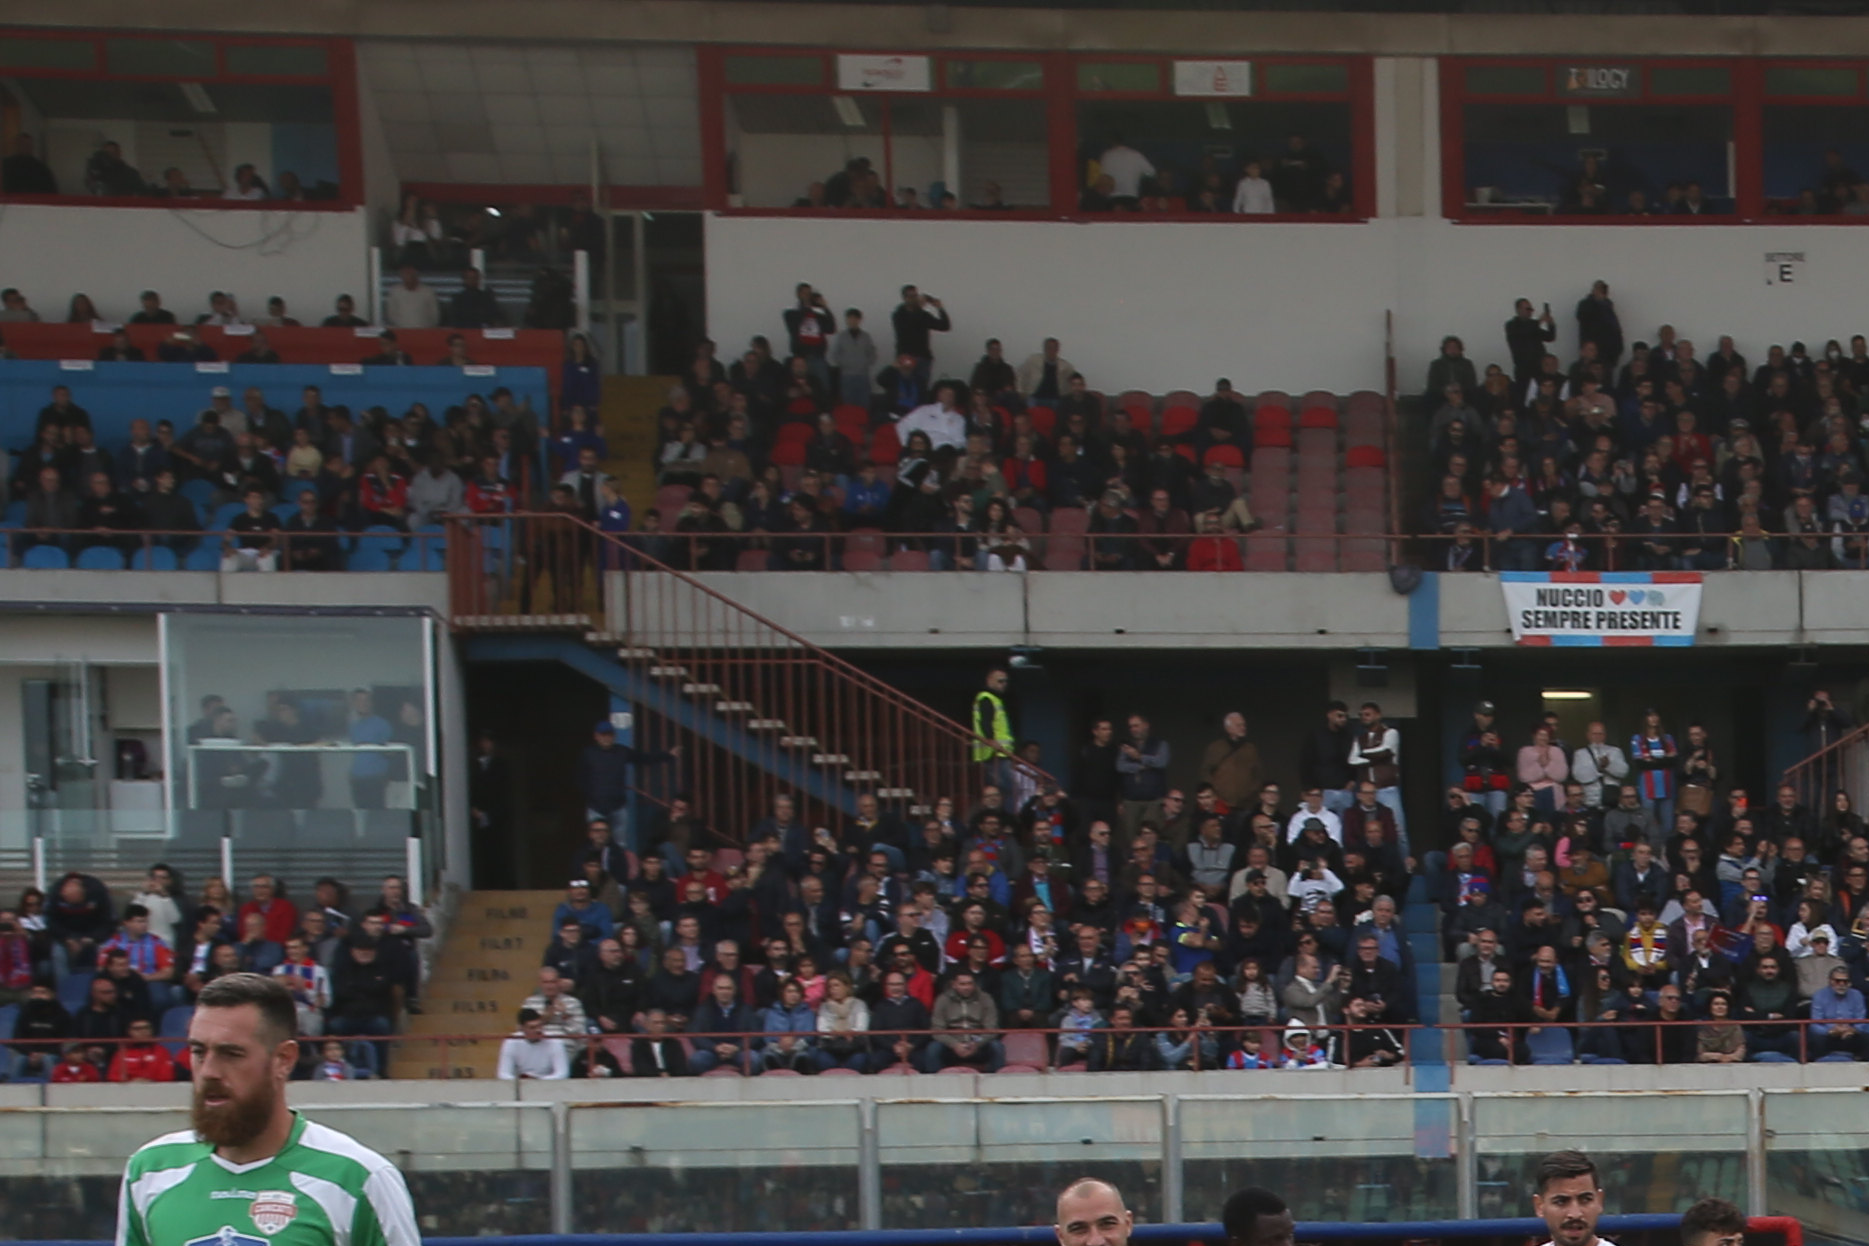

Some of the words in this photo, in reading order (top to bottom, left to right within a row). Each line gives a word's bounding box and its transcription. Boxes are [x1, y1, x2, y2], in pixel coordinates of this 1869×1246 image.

[1780, 264, 1794, 283] E
[1536, 588, 1604, 607] NUCCIO
[1521, 610, 1592, 629] SEMPRE
[1596, 610, 1682, 630] PRESENTE
